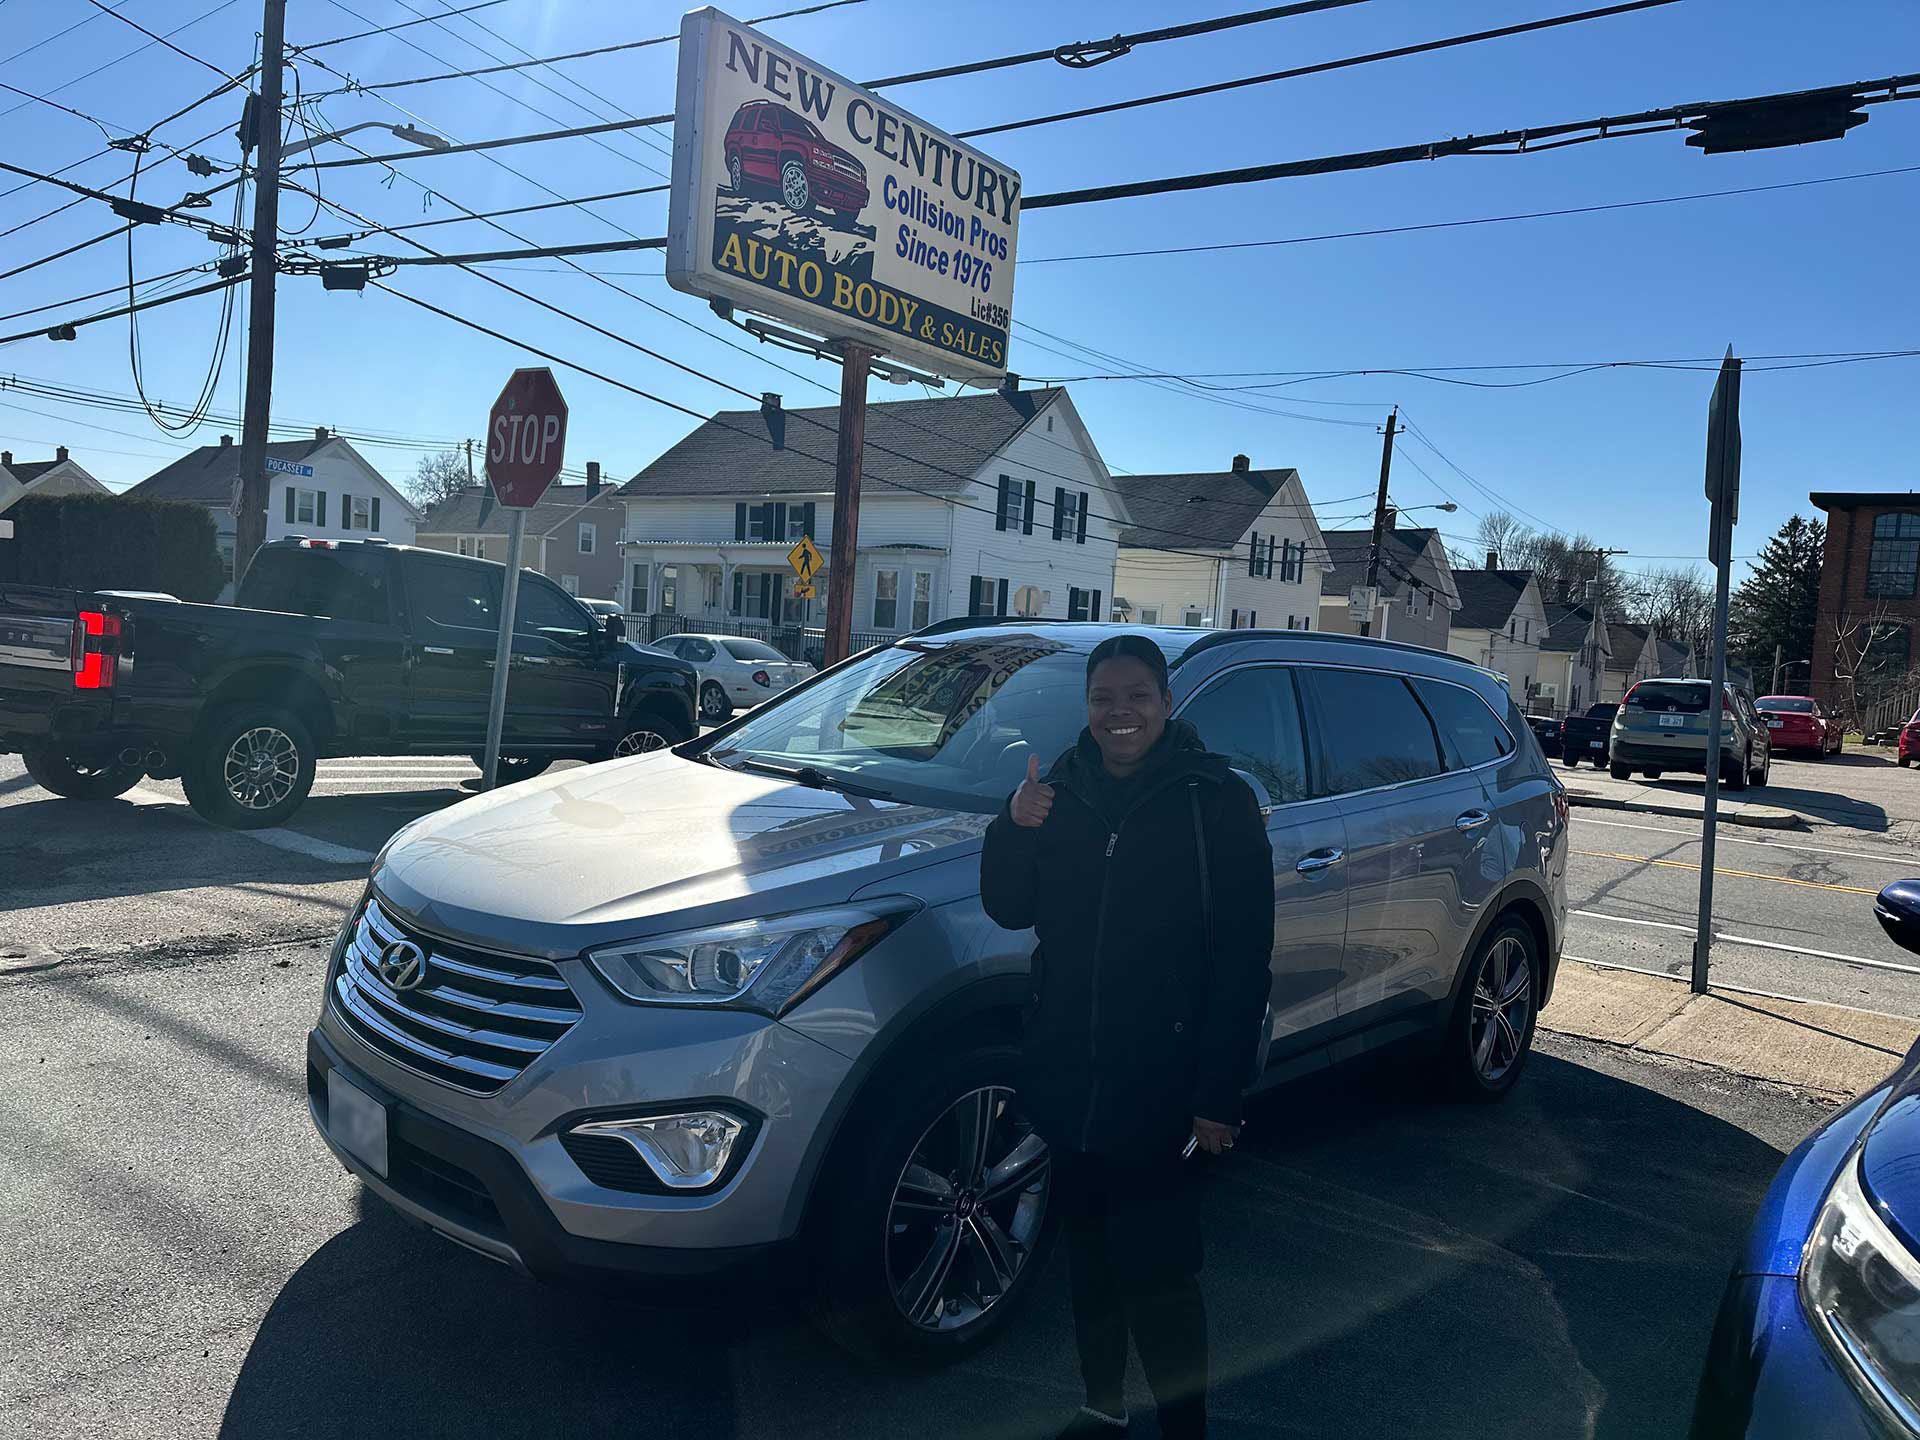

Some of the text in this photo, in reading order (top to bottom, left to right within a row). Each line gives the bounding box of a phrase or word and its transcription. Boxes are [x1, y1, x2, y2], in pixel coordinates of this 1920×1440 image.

[725, 30, 1020, 225] NEW CENTURY
[883, 174, 1008, 261] Collision Pros
[718, 232, 1002, 363] AUTO BODY & SALES
[896, 224, 991, 293] Since 1976
[268, 460, 304, 474] POCASSET
[491, 414, 560, 464] STOP
